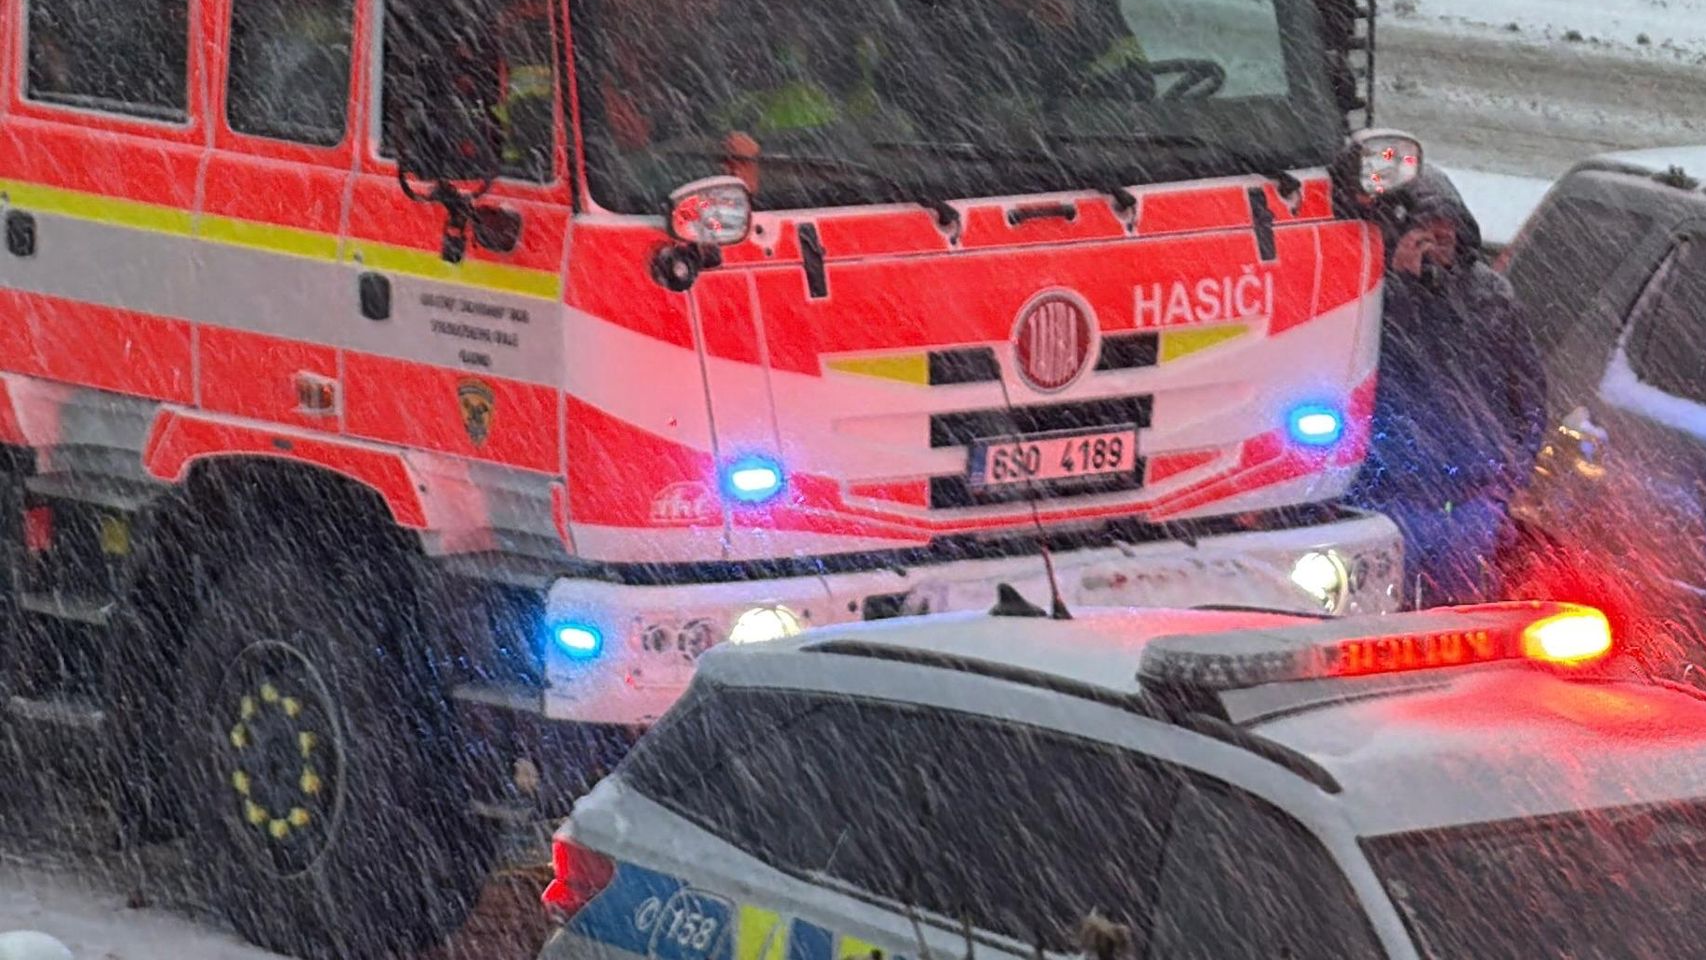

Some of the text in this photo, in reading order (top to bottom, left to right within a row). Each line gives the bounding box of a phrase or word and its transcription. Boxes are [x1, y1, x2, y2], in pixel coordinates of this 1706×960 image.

[1133, 263, 1274, 328] HASIČI
[1060, 436, 1123, 472] 4189
[666, 908, 717, 950] 158
